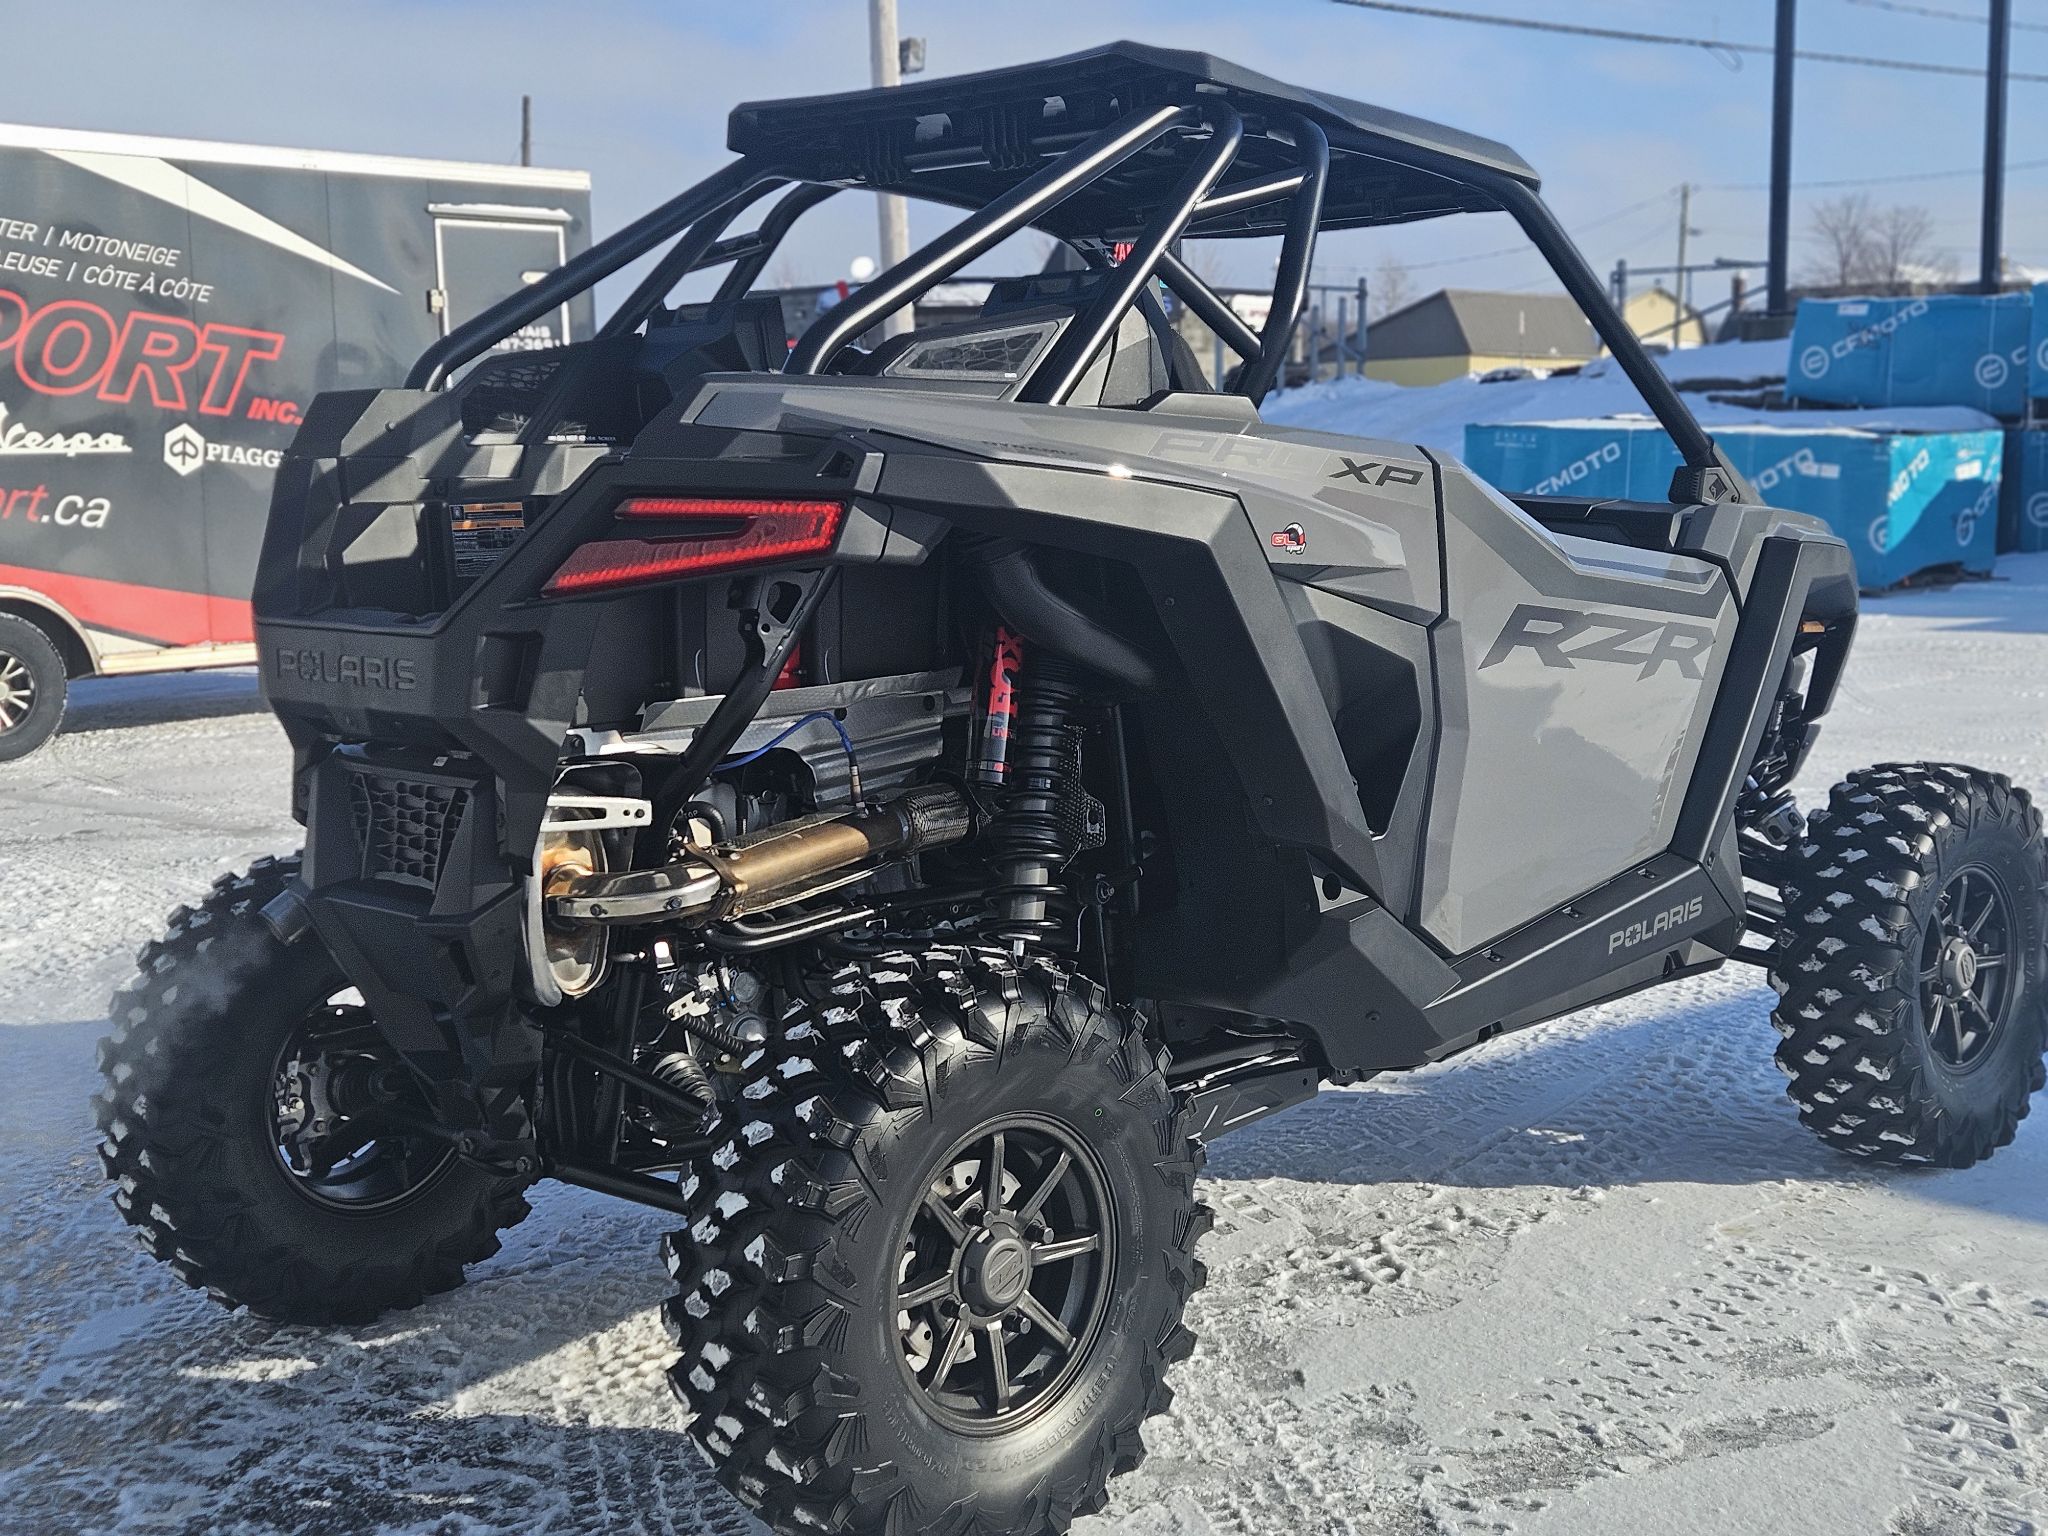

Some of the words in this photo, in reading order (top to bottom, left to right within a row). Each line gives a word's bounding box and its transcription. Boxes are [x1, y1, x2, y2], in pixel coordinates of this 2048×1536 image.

[59, 230, 181, 267] MOTONEIGE
[0, 251, 63, 278] EUSE
[83, 264, 140, 291] CÔTE
[139, 271, 155, 294] À
[159, 277, 214, 303] CÔTE
[1832, 299, 1929, 358] CFMOTO
[247, 397, 304, 425] INC.
[205, 442, 284, 468] PIAGG
[1328, 456, 1424, 487] XP
[1478, 603, 1716, 682] RZR
[276, 650, 416, 690] POLARIS
[1608, 896, 1703, 955] POLARIS
